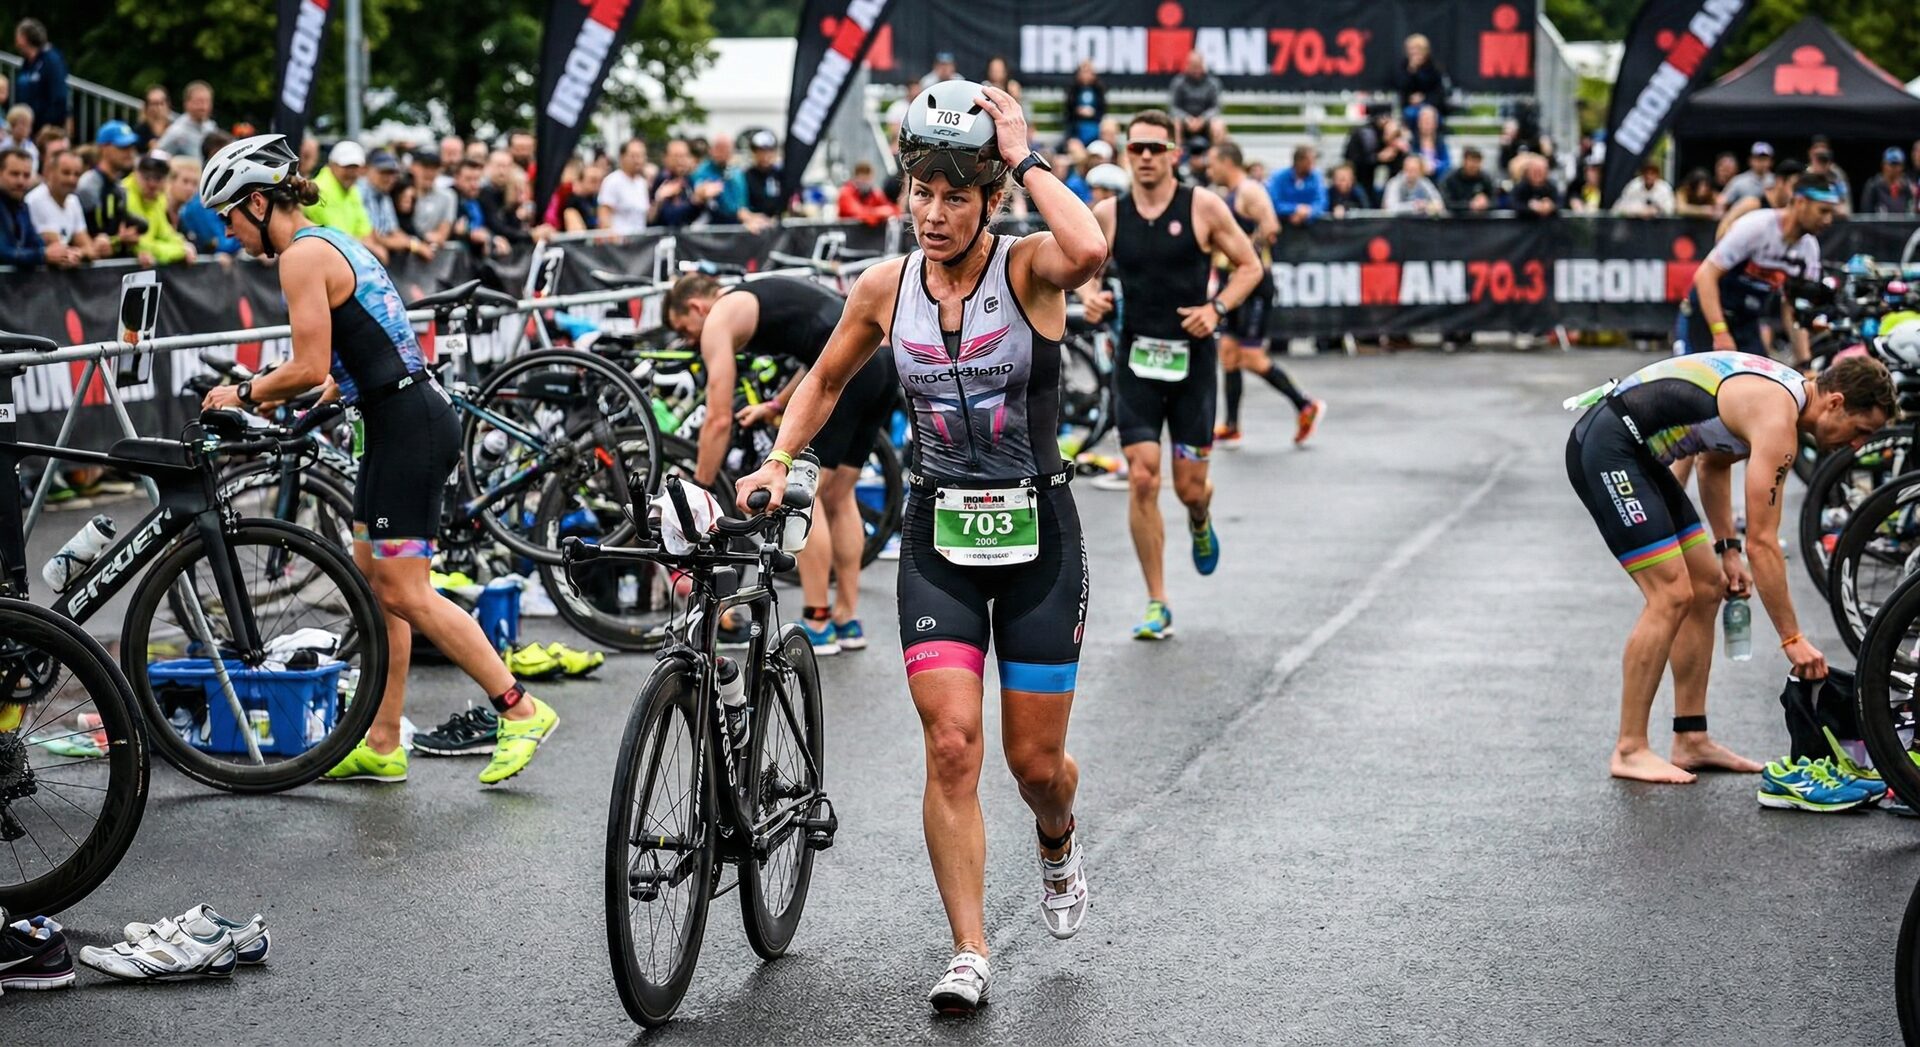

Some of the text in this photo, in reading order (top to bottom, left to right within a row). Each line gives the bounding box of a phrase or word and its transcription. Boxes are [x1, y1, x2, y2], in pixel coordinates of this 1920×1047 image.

[282, 0, 328, 113] IRON
[1020, 2, 1365, 76] IRONMAN 70.3
[936, 111, 961, 126] 703
[958, 512, 1014, 536] 703
